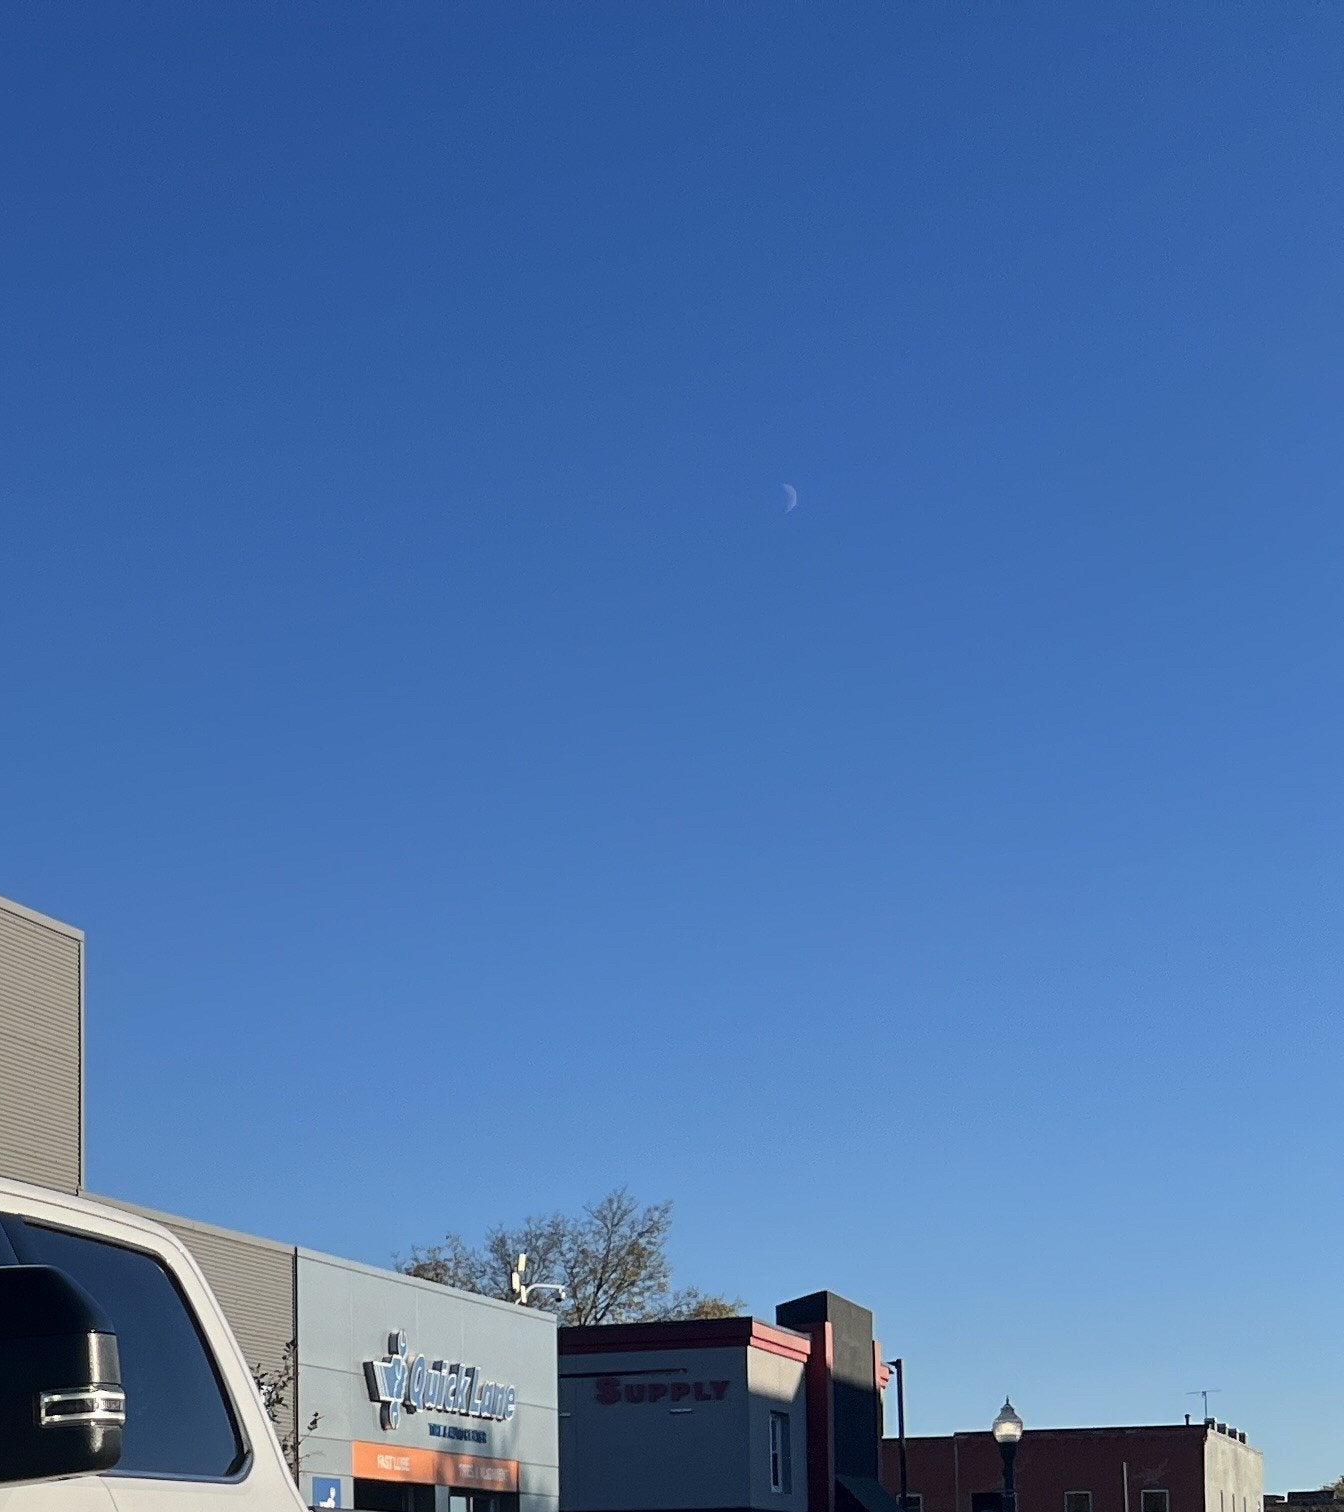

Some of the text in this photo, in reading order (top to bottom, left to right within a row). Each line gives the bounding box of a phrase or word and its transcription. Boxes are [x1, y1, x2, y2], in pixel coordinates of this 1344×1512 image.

[409, 1353, 516, 1421] Quick Lane
[596, 1376, 731, 1406] SUPPLY
